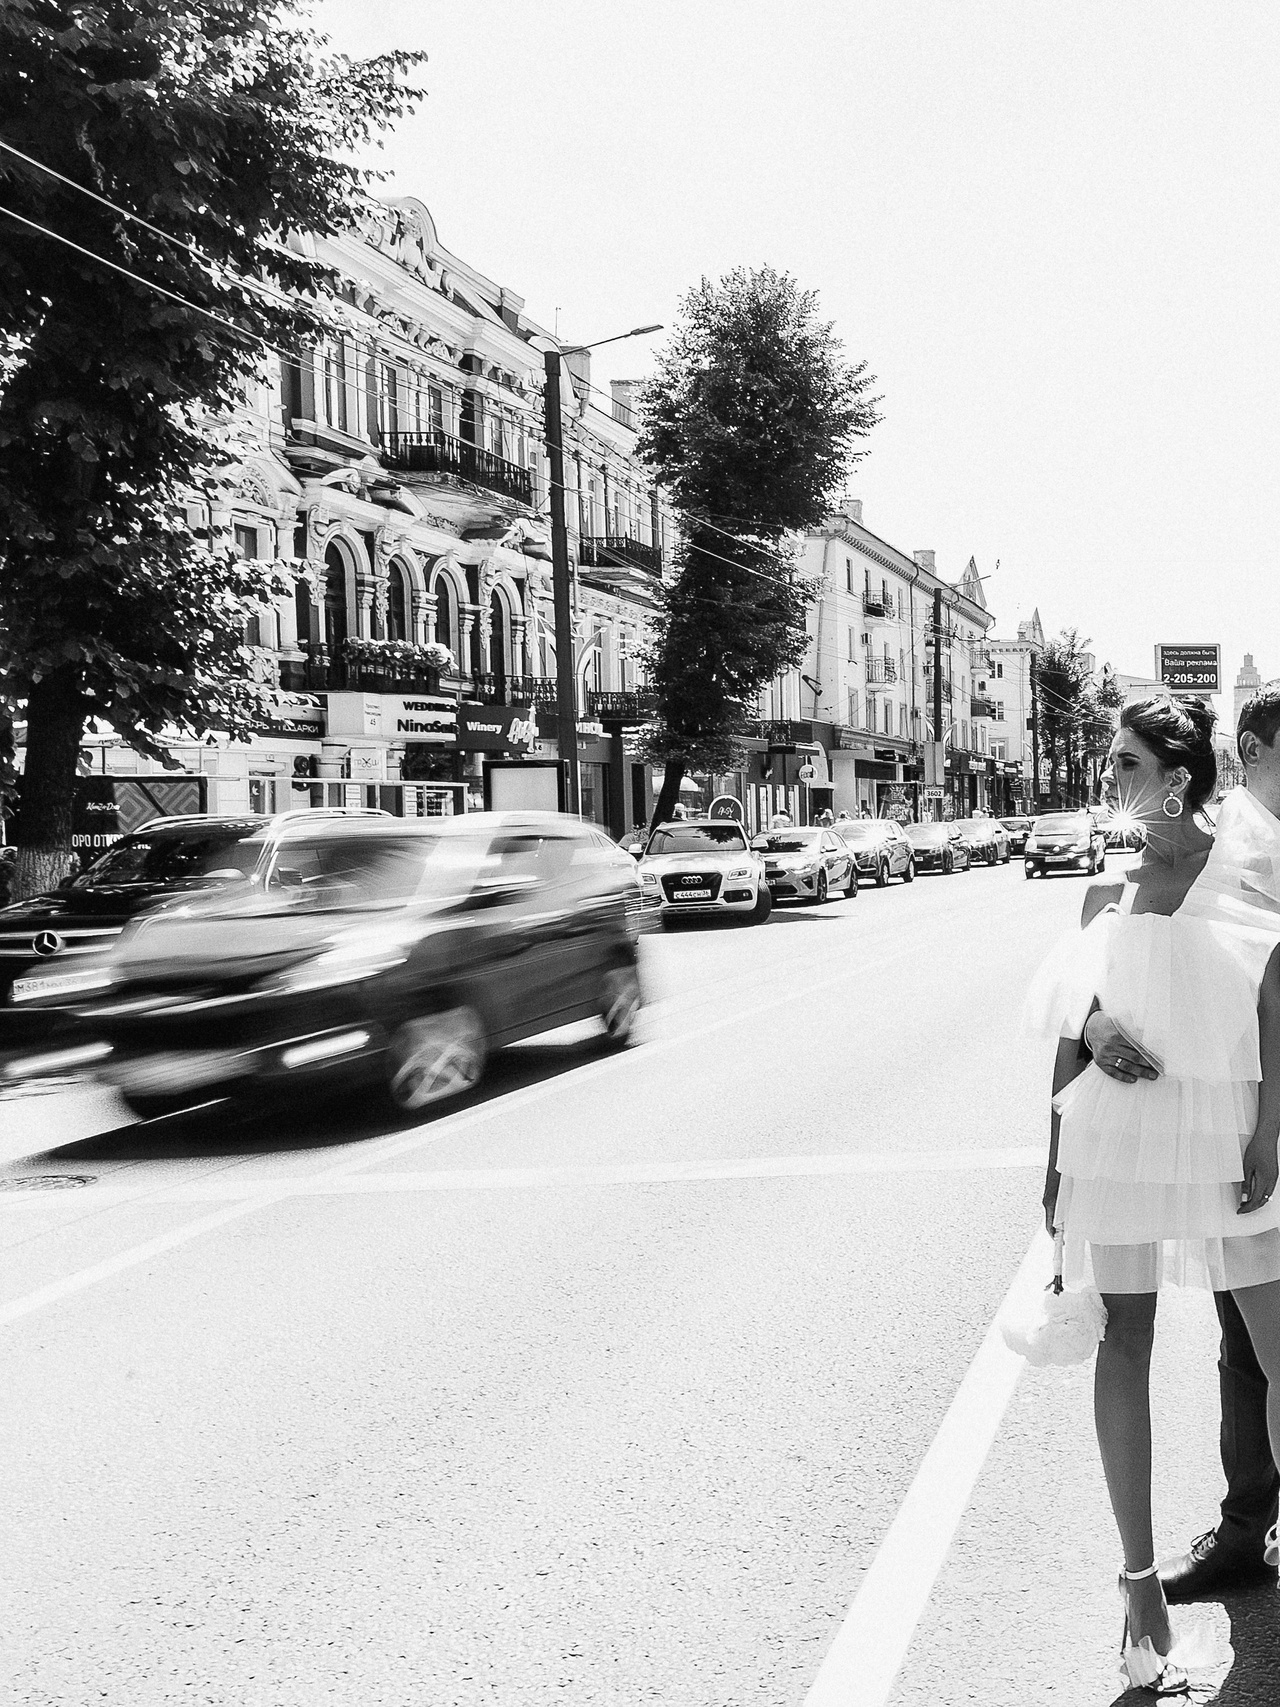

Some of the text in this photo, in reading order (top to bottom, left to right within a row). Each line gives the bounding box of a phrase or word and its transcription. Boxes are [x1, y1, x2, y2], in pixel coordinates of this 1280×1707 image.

[1164, 658, 1218, 668] Ваша реклама
[1163, 673, 1216, 684] 2-205-200
[466, 721, 503, 735] Winery
